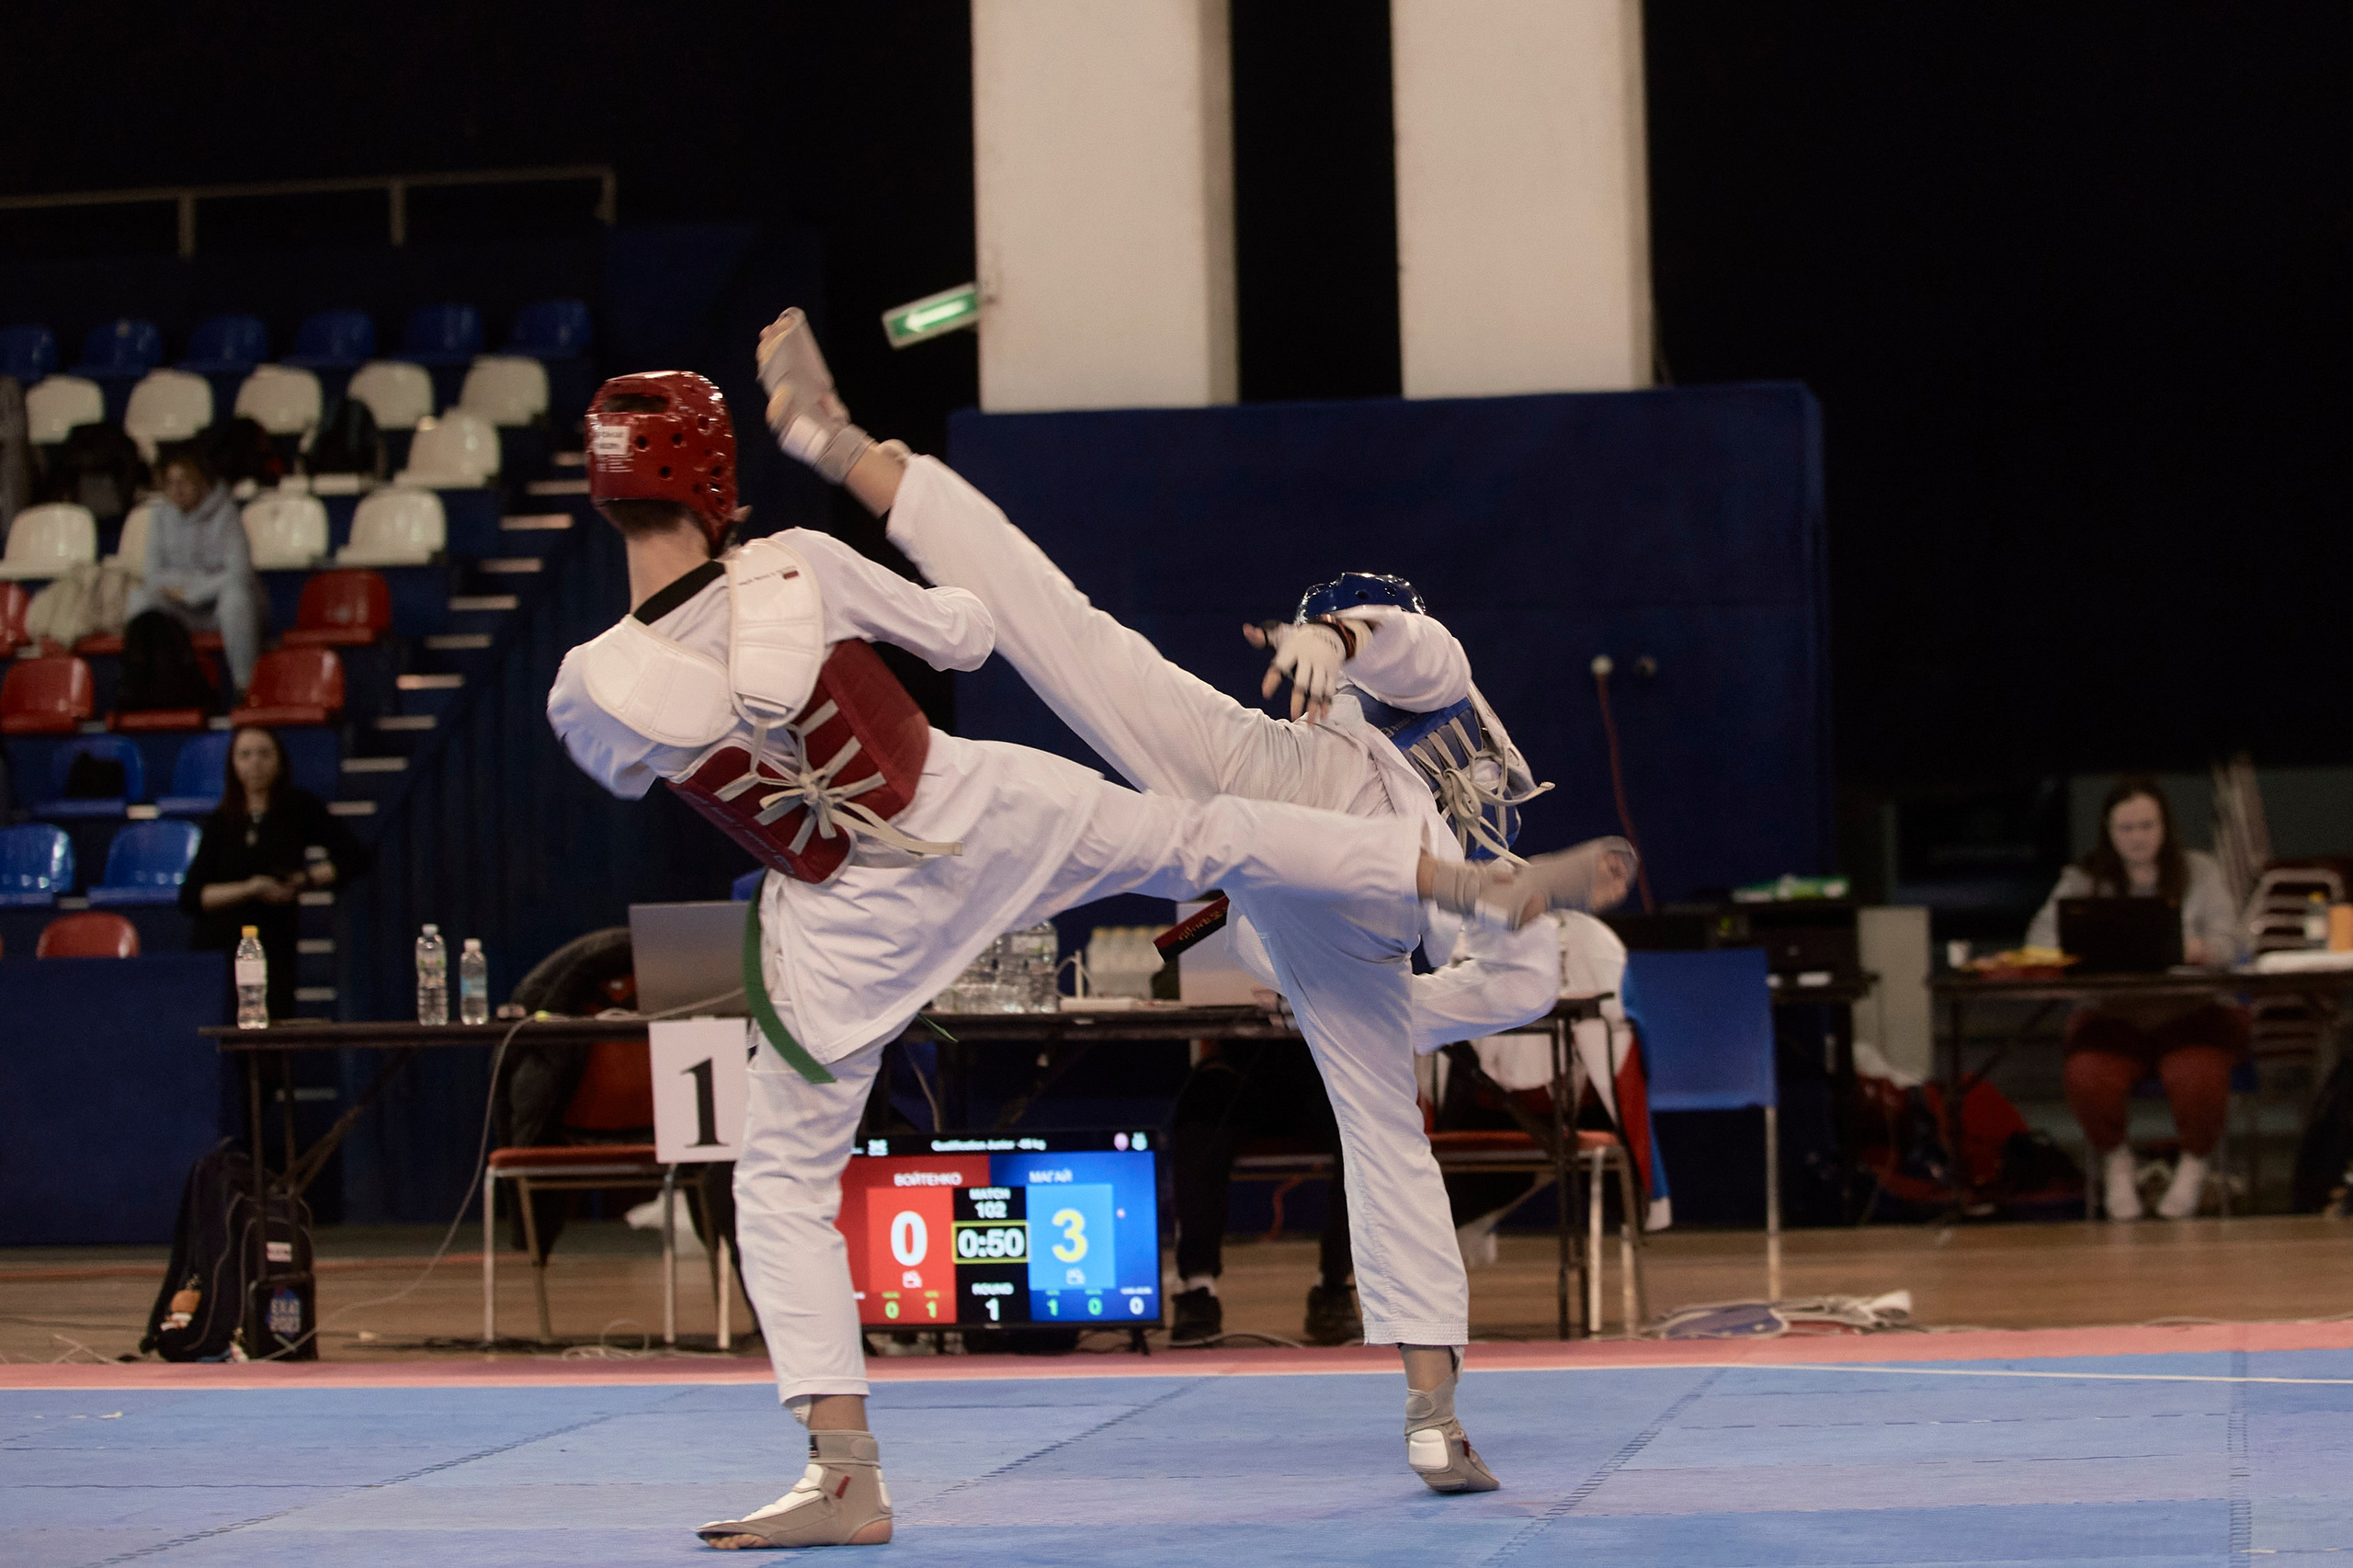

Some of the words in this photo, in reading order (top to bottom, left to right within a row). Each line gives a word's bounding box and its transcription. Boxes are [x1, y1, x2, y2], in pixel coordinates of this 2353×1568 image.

[680, 1056, 730, 1148] 1
[974, 1200, 1007, 1219] 102
[890, 1210, 928, 1267] 0
[958, 1228, 1026, 1258] 0:50
[1051, 1209, 1088, 1263] 3
[885, 1301, 900, 1320] 0
[926, 1300, 937, 1319] 1
[985, 1297, 1000, 1321] 1
[1047, 1297, 1059, 1316] 1
[1087, 1297, 1103, 1316] 0
[1129, 1296, 1144, 1315] 0
